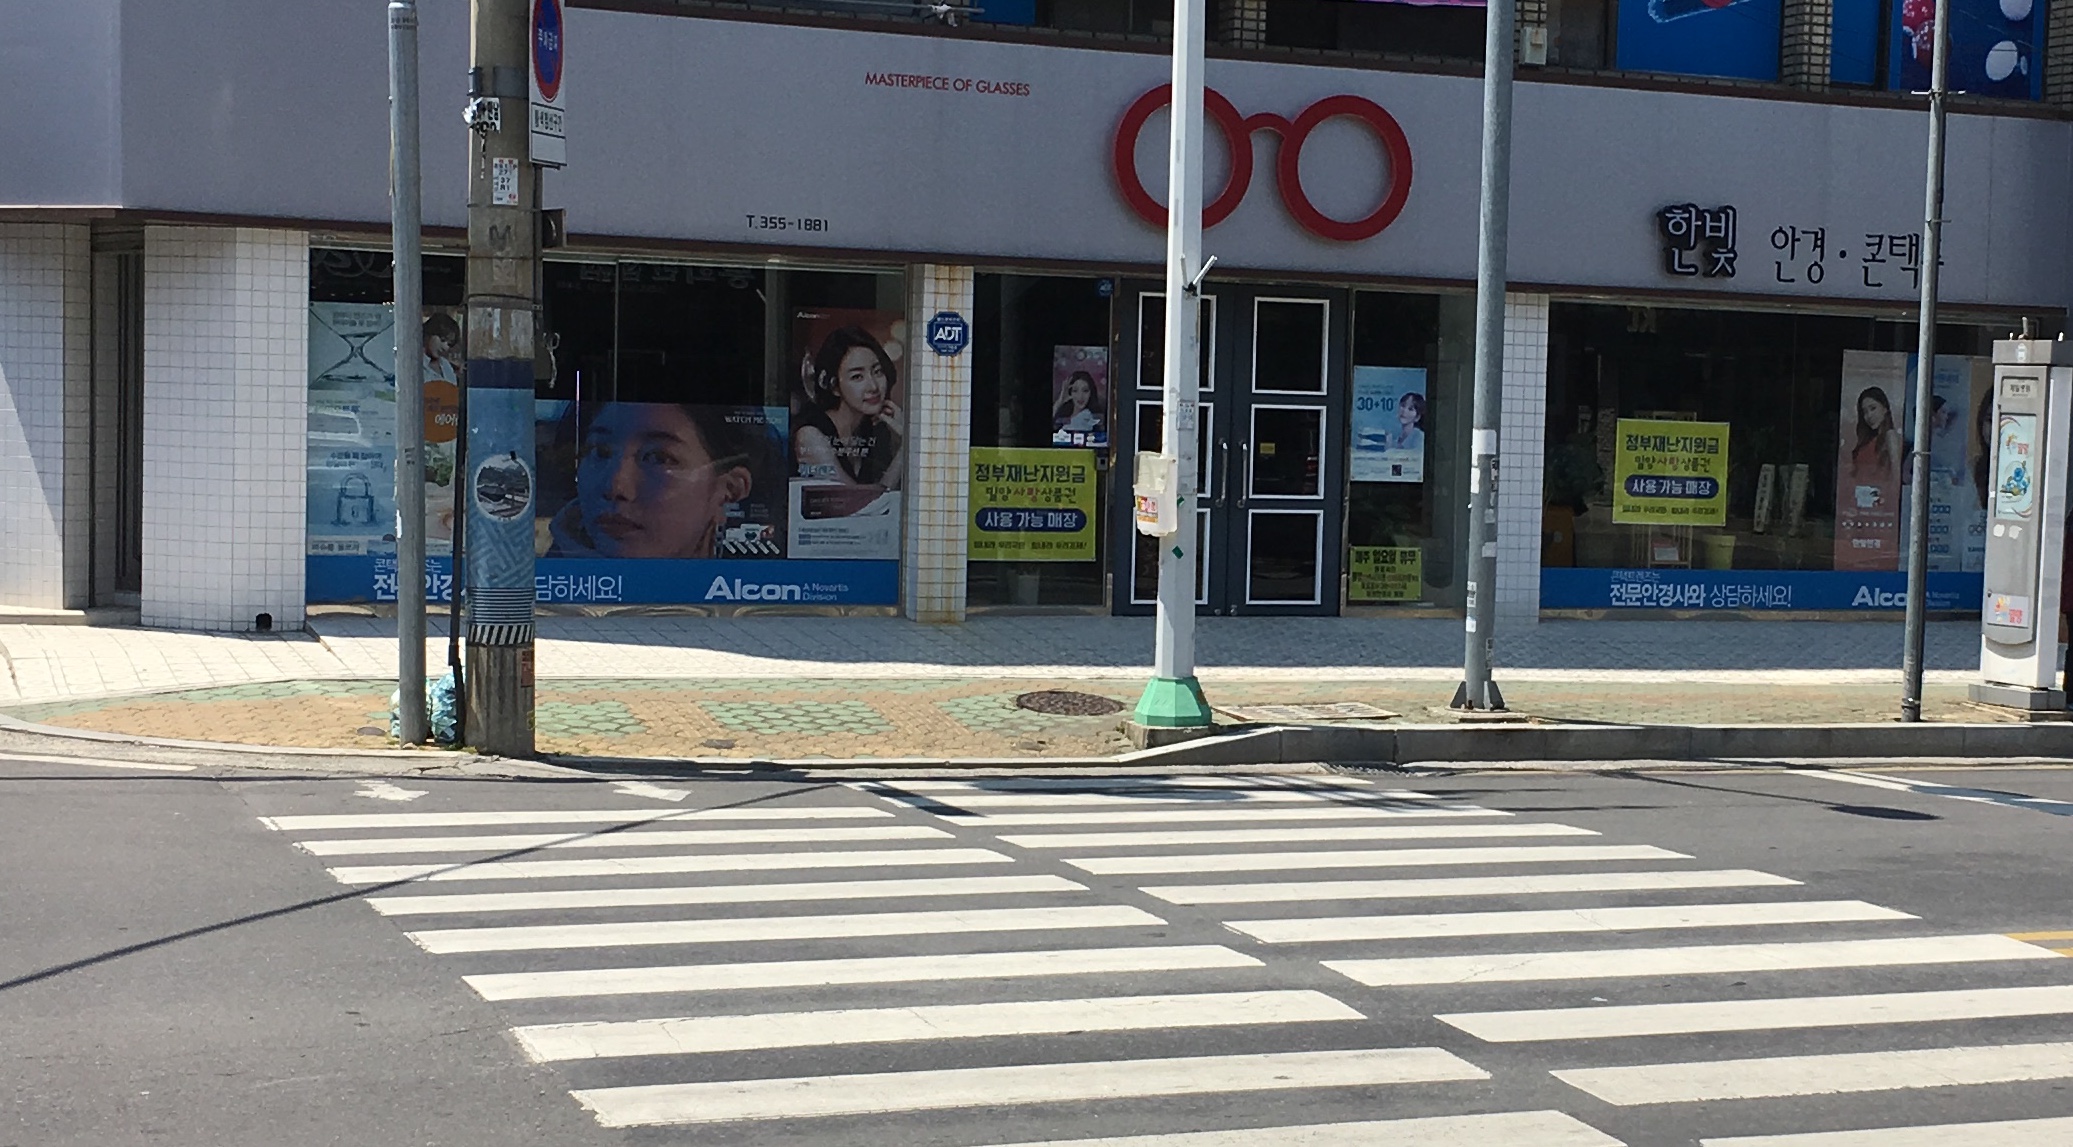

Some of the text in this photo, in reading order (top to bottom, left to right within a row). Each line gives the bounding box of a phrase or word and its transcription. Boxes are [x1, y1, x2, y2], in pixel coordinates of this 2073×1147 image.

[864, 72, 1030, 96] MASTERPIECE OF GLASSES
[745, 214, 829, 231] T.355-1881
[1662, 203, 1738, 279] 한빛
[934, 326, 962, 342] ADT
[1626, 434, 1719, 454] 정부재난지원금
[974, 463, 1086, 483] 정부재난지원금
[1632, 479, 1712, 495] 사용 가능 매장
[984, 511, 1078, 528] 사용 가능 매장
[704, 576, 801, 600] Alcon
[1609, 583, 1792, 607] 전문안경사와 상담하세요!
[1851, 585, 1908, 606] Alco
